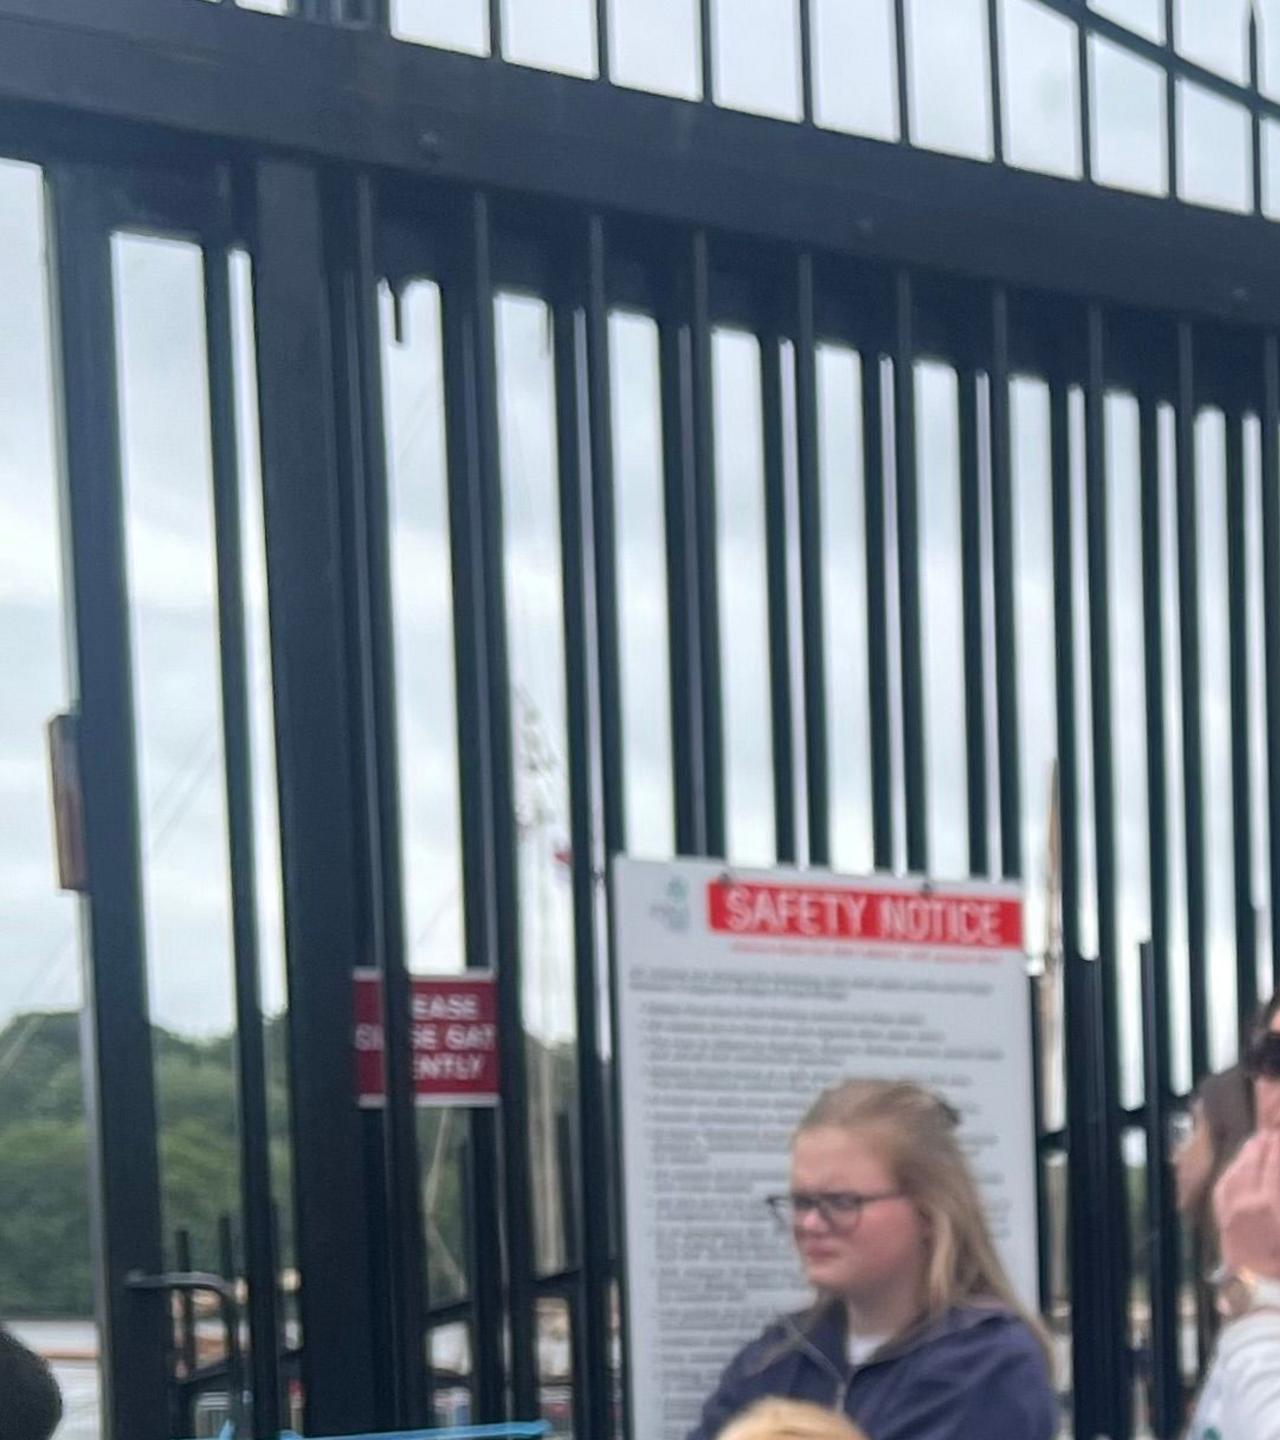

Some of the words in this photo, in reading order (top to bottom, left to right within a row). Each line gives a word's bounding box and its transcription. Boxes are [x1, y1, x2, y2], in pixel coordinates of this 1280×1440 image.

[724, 886, 868, 934] SAFETY
[880, 894, 1003, 945] NOTICE
[411, 994, 479, 1021] EASE
[445, 1023, 496, 1050] GAT
